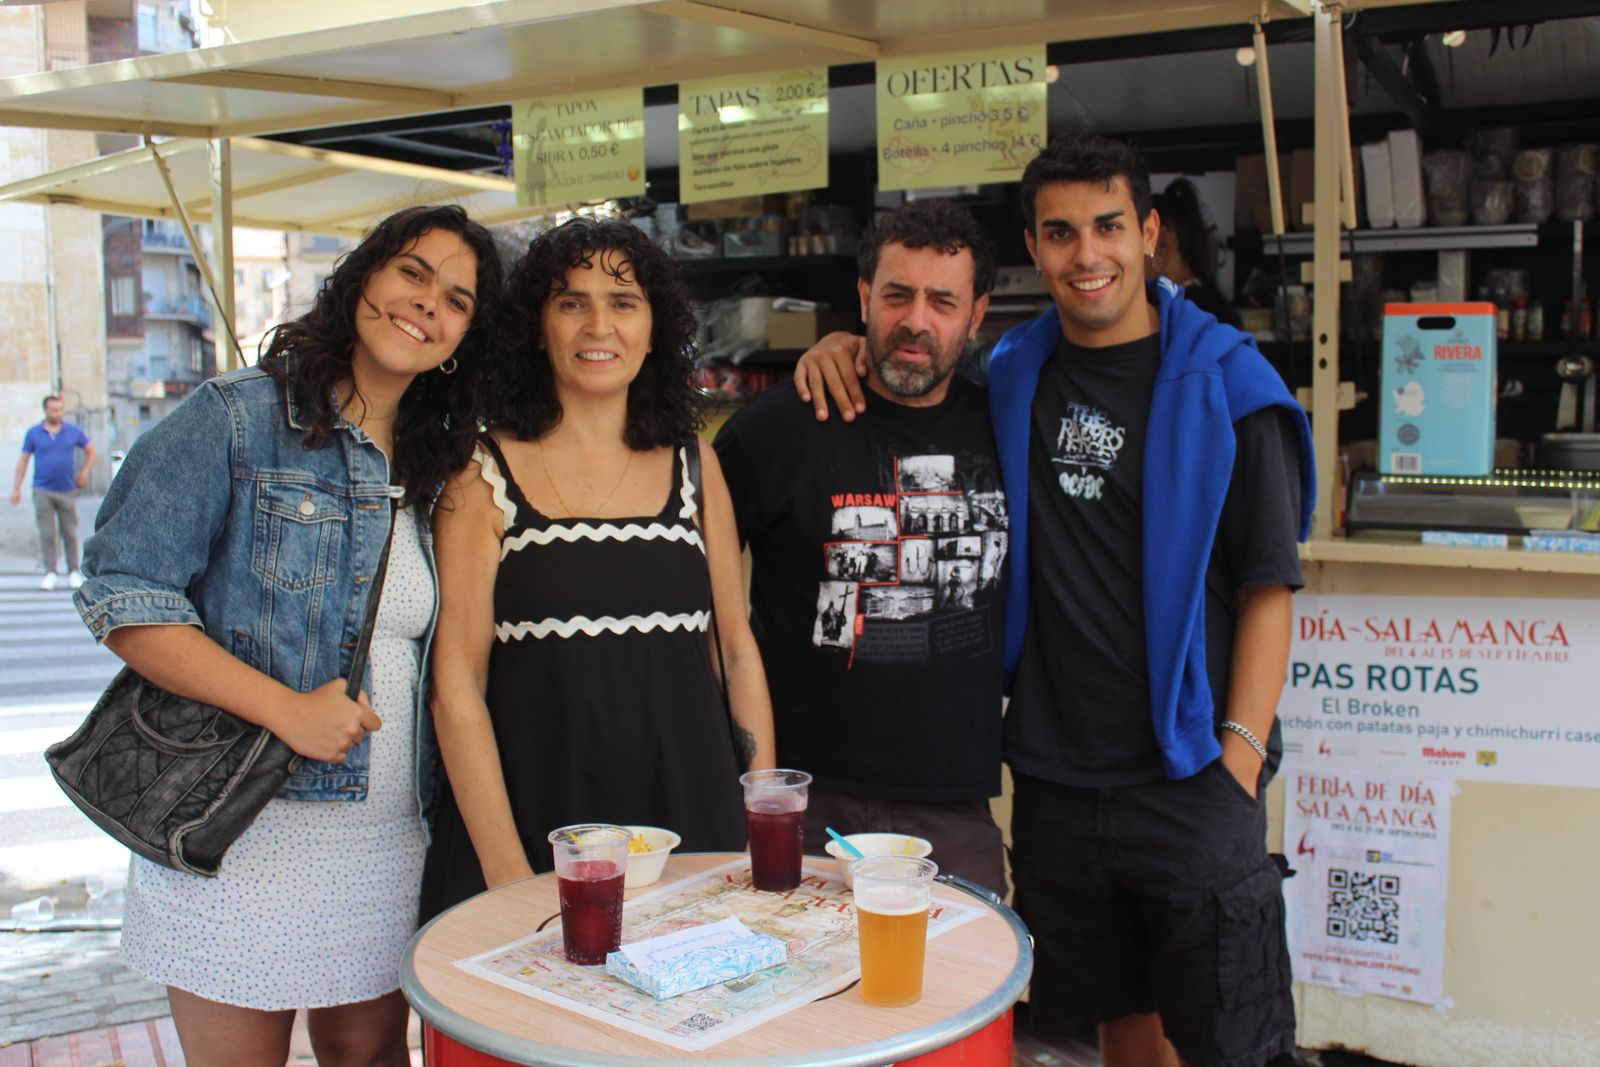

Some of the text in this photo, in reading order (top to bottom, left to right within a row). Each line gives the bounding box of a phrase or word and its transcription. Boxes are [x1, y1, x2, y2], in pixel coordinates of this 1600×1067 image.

[887, 58, 1034, 97] OFERTAS
[689, 86, 761, 116] TAPAS
[806, 82, 816, 97] €
[893, 117, 928, 131] Caña
[941, 110, 986, 128] pincho
[609, 143, 620, 157] €
[883, 145, 928, 160] Botella
[941, 142, 950, 154] 4
[954, 139, 1007, 156] pinchos
[1434, 344, 1483, 361] RIVERA
[831, 493, 897, 508] WARSAW
[1288, 662, 1479, 694] PAS ROTAS
[1322, 697, 1420, 717] El Broken
[1327, 720, 1353, 731] con
[1357, 720, 1412, 735] patatas
[1418, 724, 1450, 738] paja
[1454, 725, 1463, 739] y
[1466, 724, 1561, 740] chimichurri
[1296, 776, 1438, 806] FERIA DE DÍA
[1296, 800, 1438, 830] SALAMANCA
